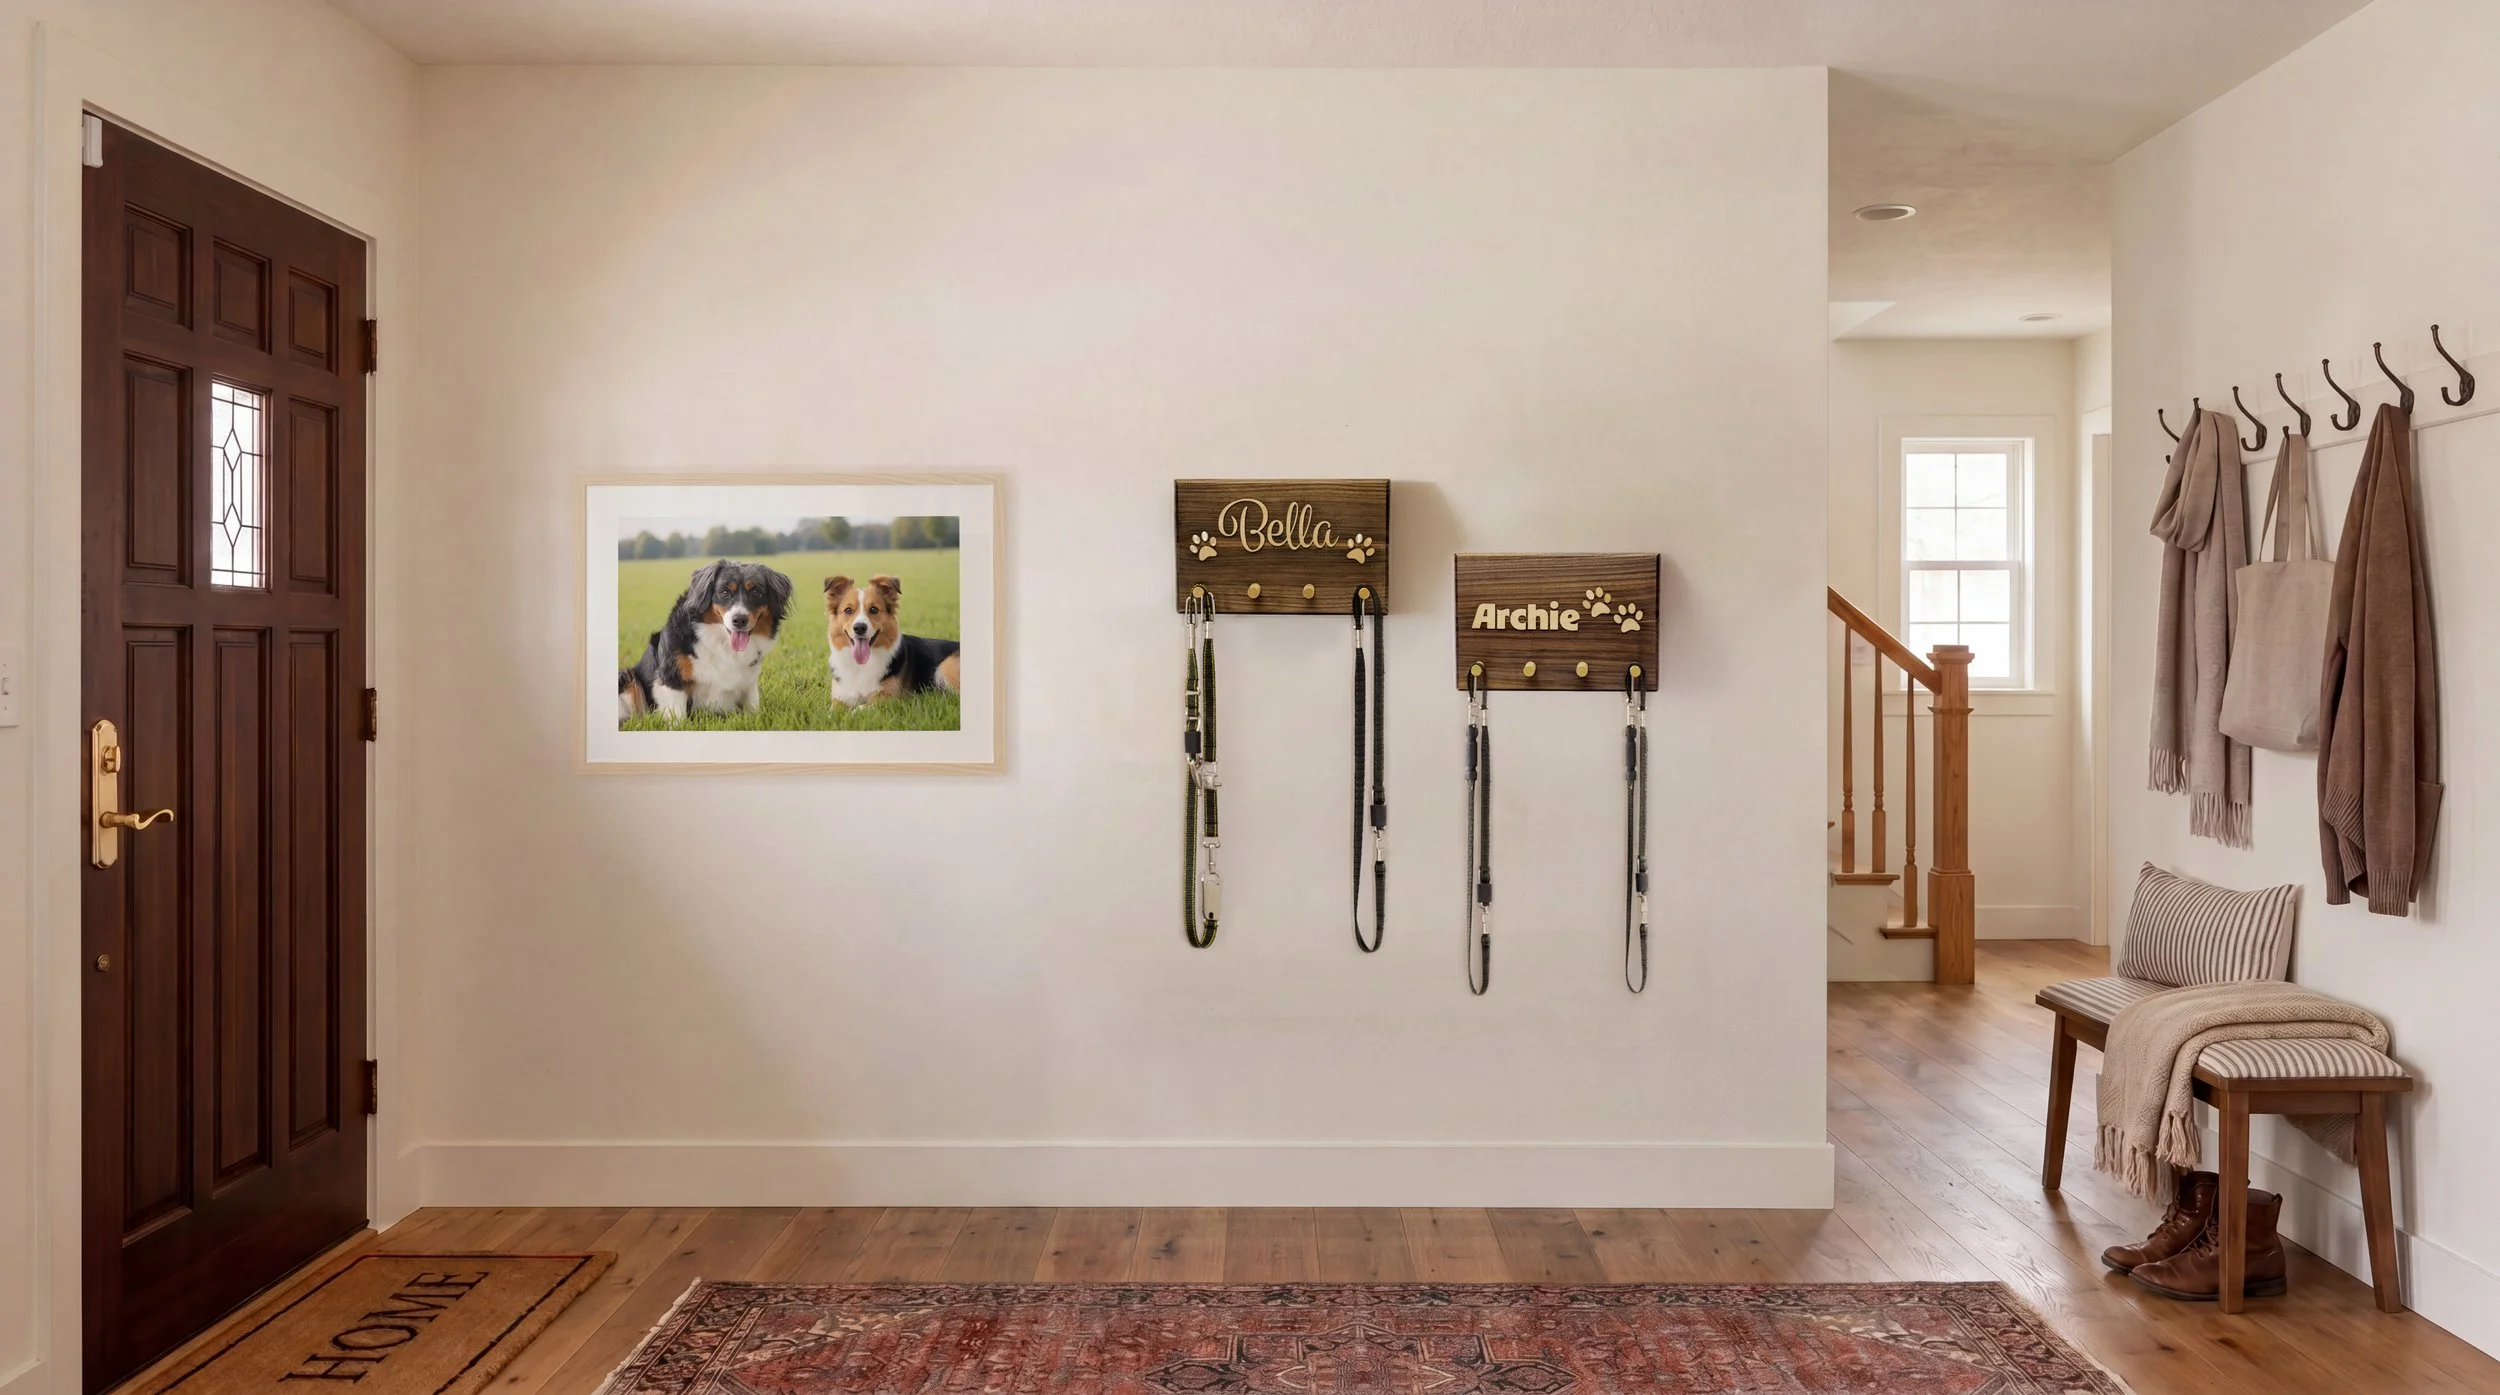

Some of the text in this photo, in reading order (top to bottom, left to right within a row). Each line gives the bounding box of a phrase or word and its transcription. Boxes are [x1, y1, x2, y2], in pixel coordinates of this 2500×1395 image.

[1218, 498, 1339, 552] Bella
[1472, 600, 1580, 631] Archie
[279, 1271, 490, 1383] HOME
